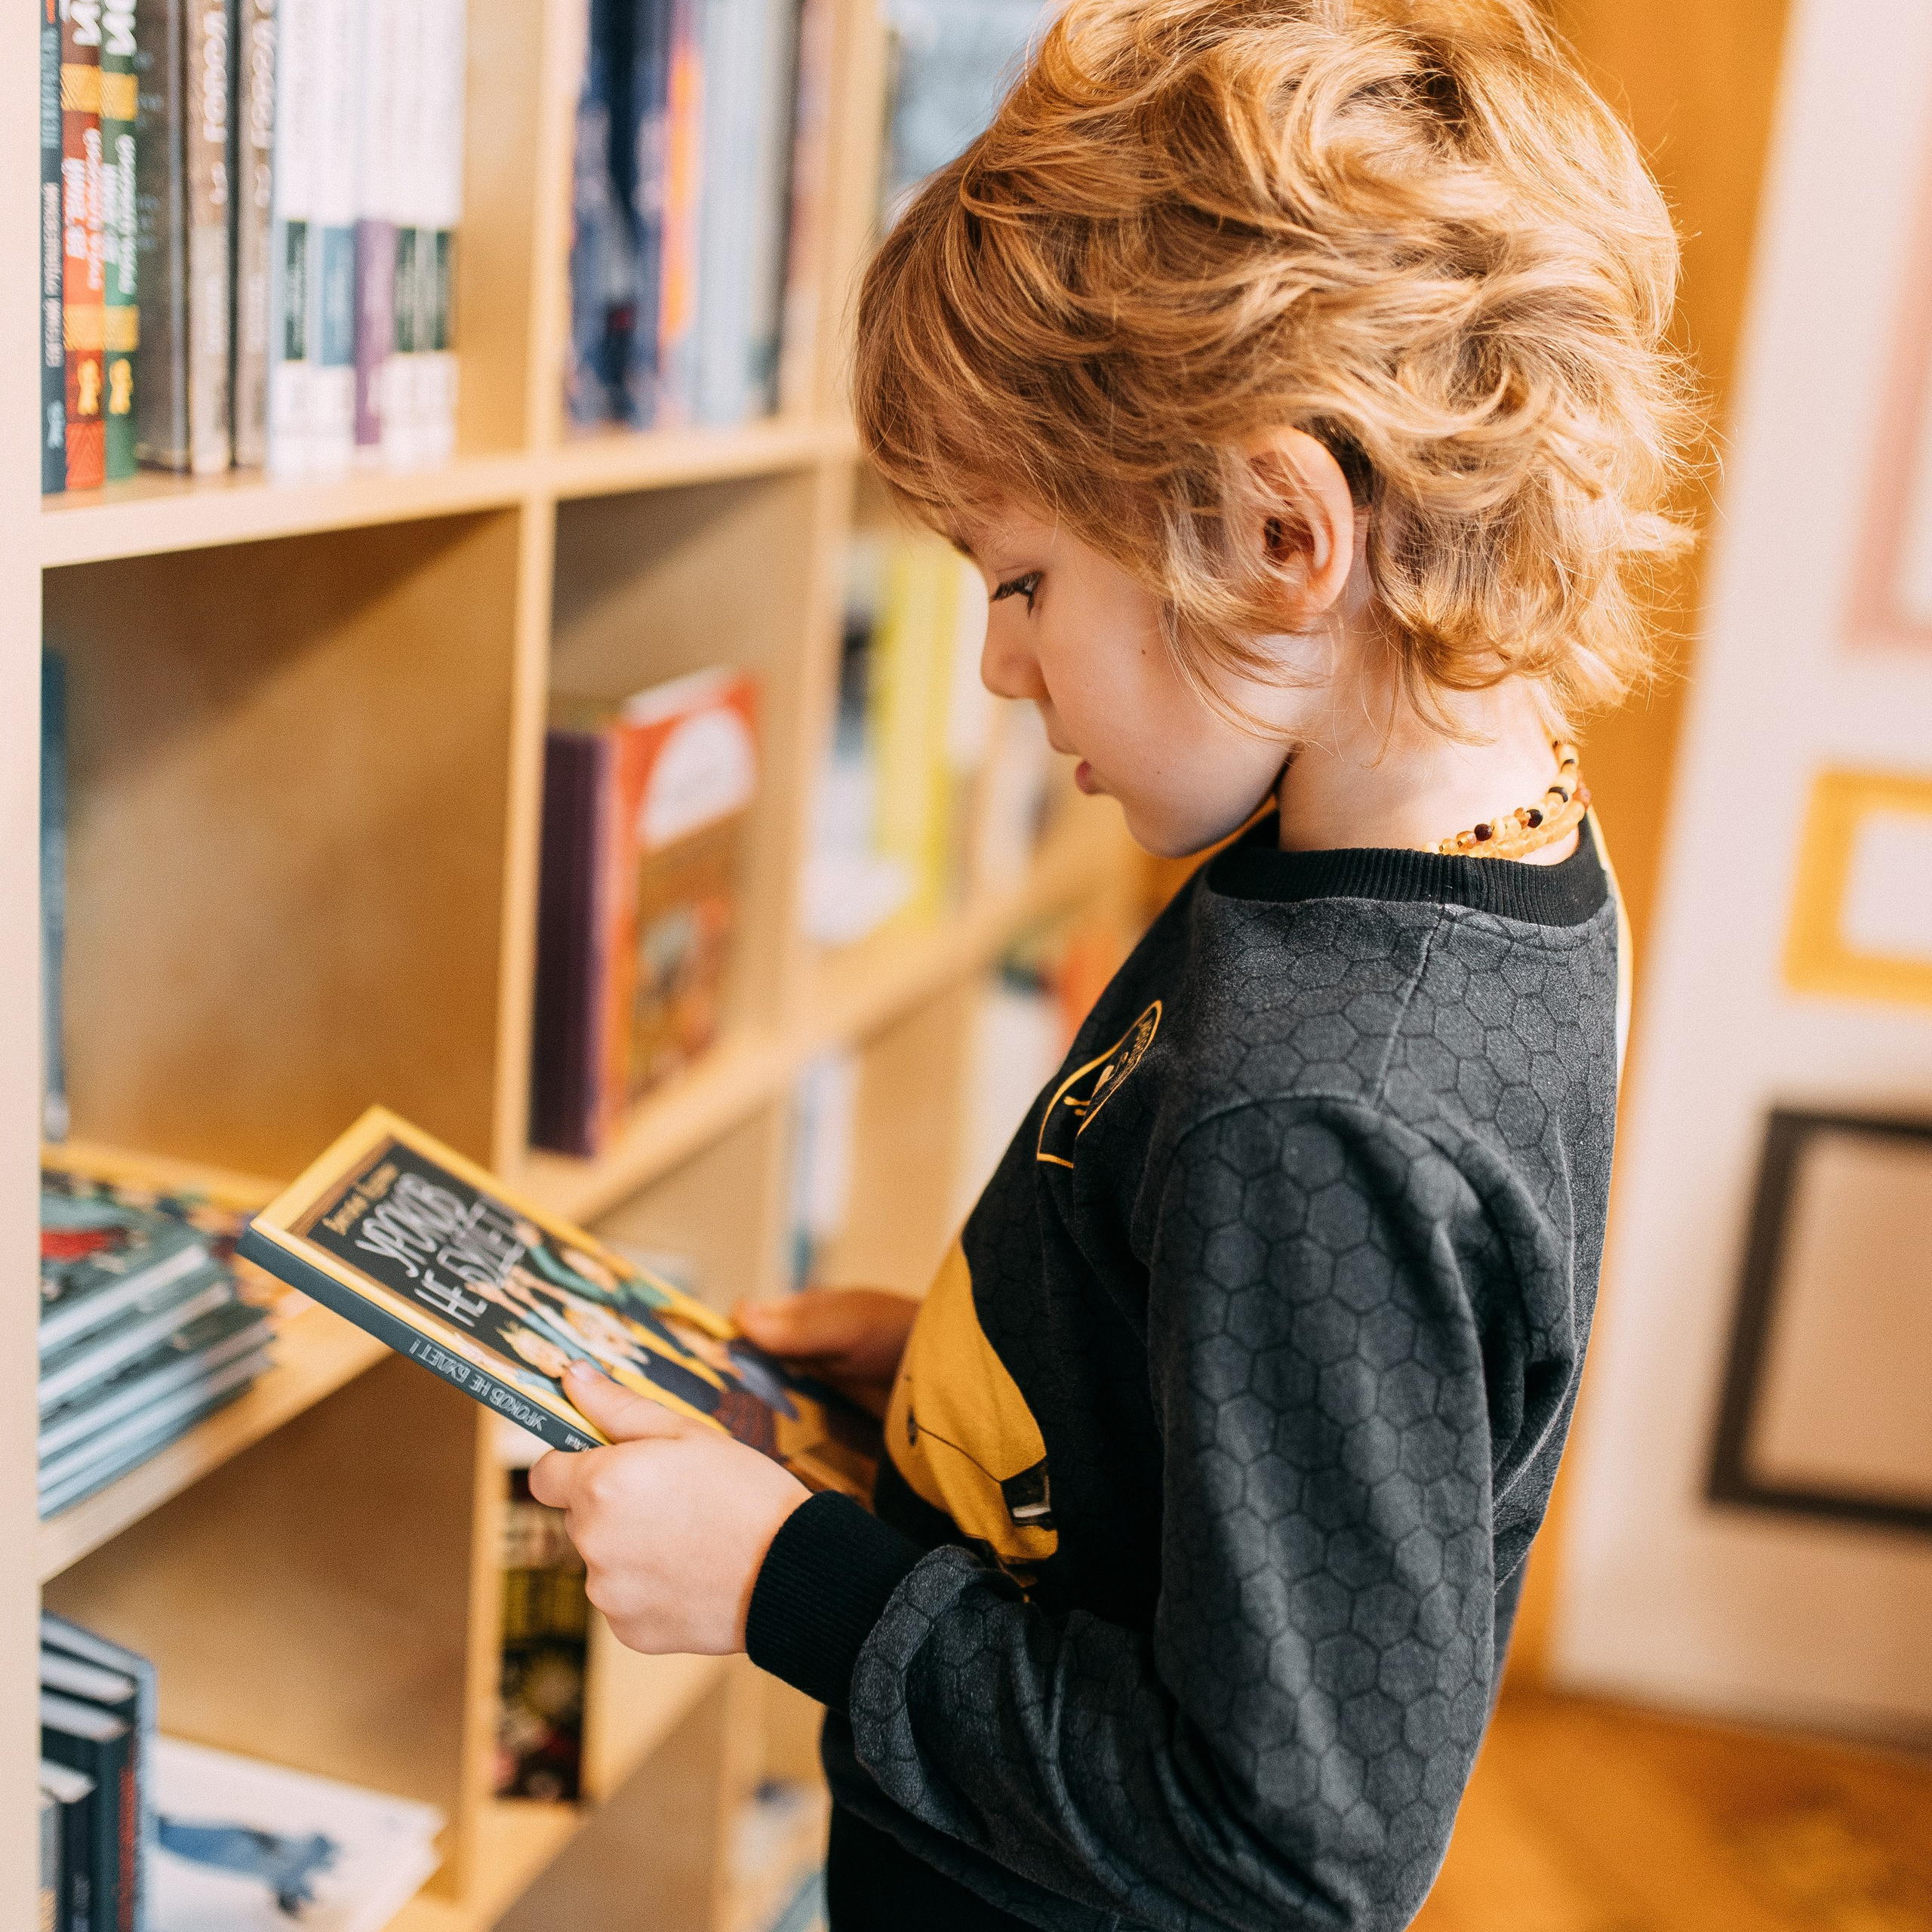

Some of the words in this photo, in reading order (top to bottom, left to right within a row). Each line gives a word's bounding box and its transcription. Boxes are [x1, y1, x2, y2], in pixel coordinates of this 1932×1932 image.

[354, 1172, 469, 1278] УРОКОВ
[414, 1269, 488, 1327] НЕ
[469, 1375, 492, 1397] НЕ
[490, 1387, 548, 1432] УРОКОВ
